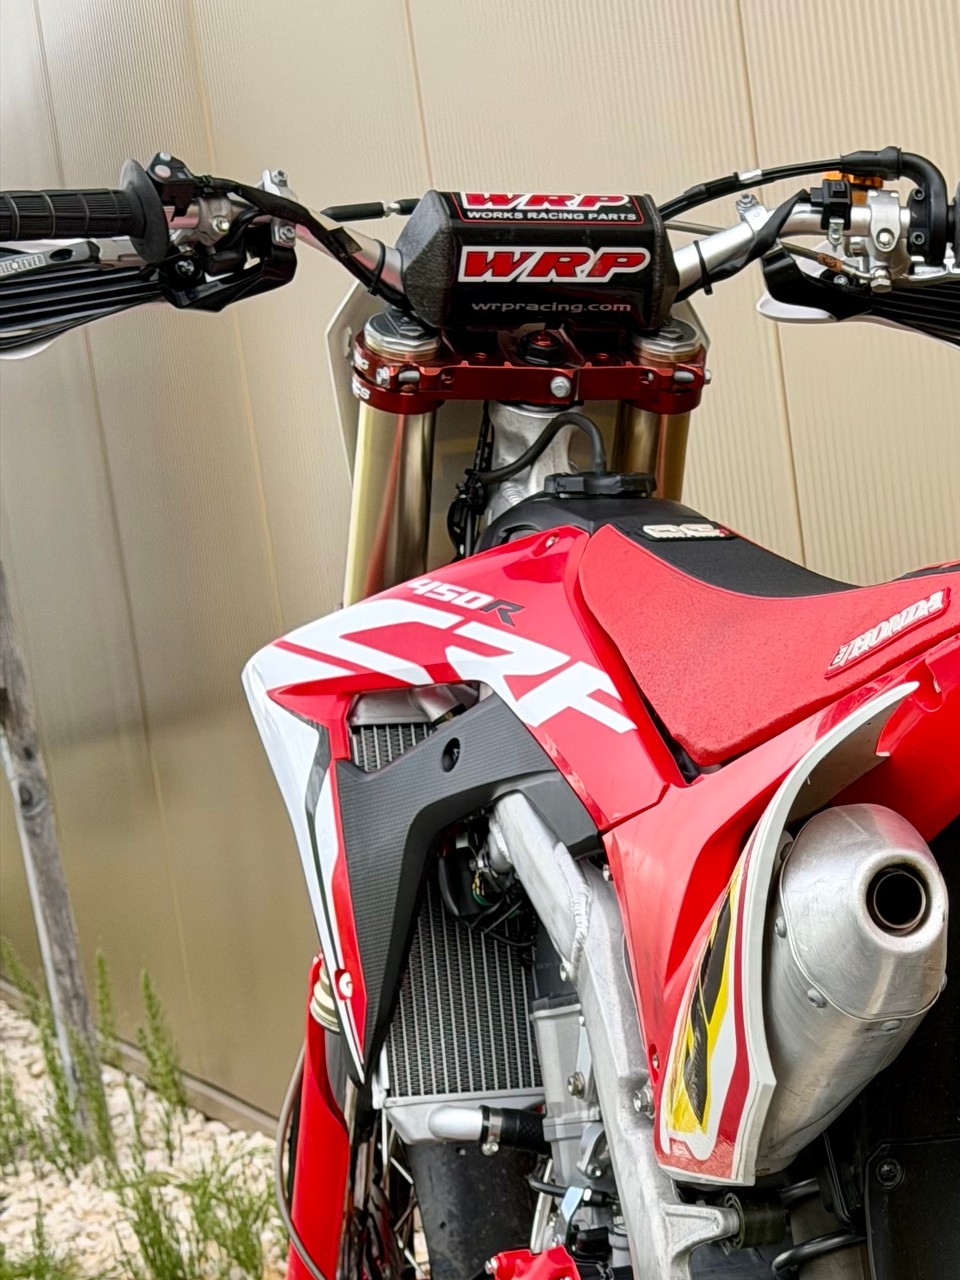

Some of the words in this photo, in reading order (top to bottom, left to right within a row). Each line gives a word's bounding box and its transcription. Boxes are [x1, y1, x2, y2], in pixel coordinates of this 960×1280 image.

[461, 192, 630, 210] WRP
[467, 211, 523, 219] WORKS
[527, 211, 584, 220] RACING
[588, 212, 637, 221] PARTS
[459, 247, 650, 282] WRP
[471, 301, 631, 314] wrpracing.com
[847, 590, 944, 661] HONDA
[282, 598, 638, 734] CRF
